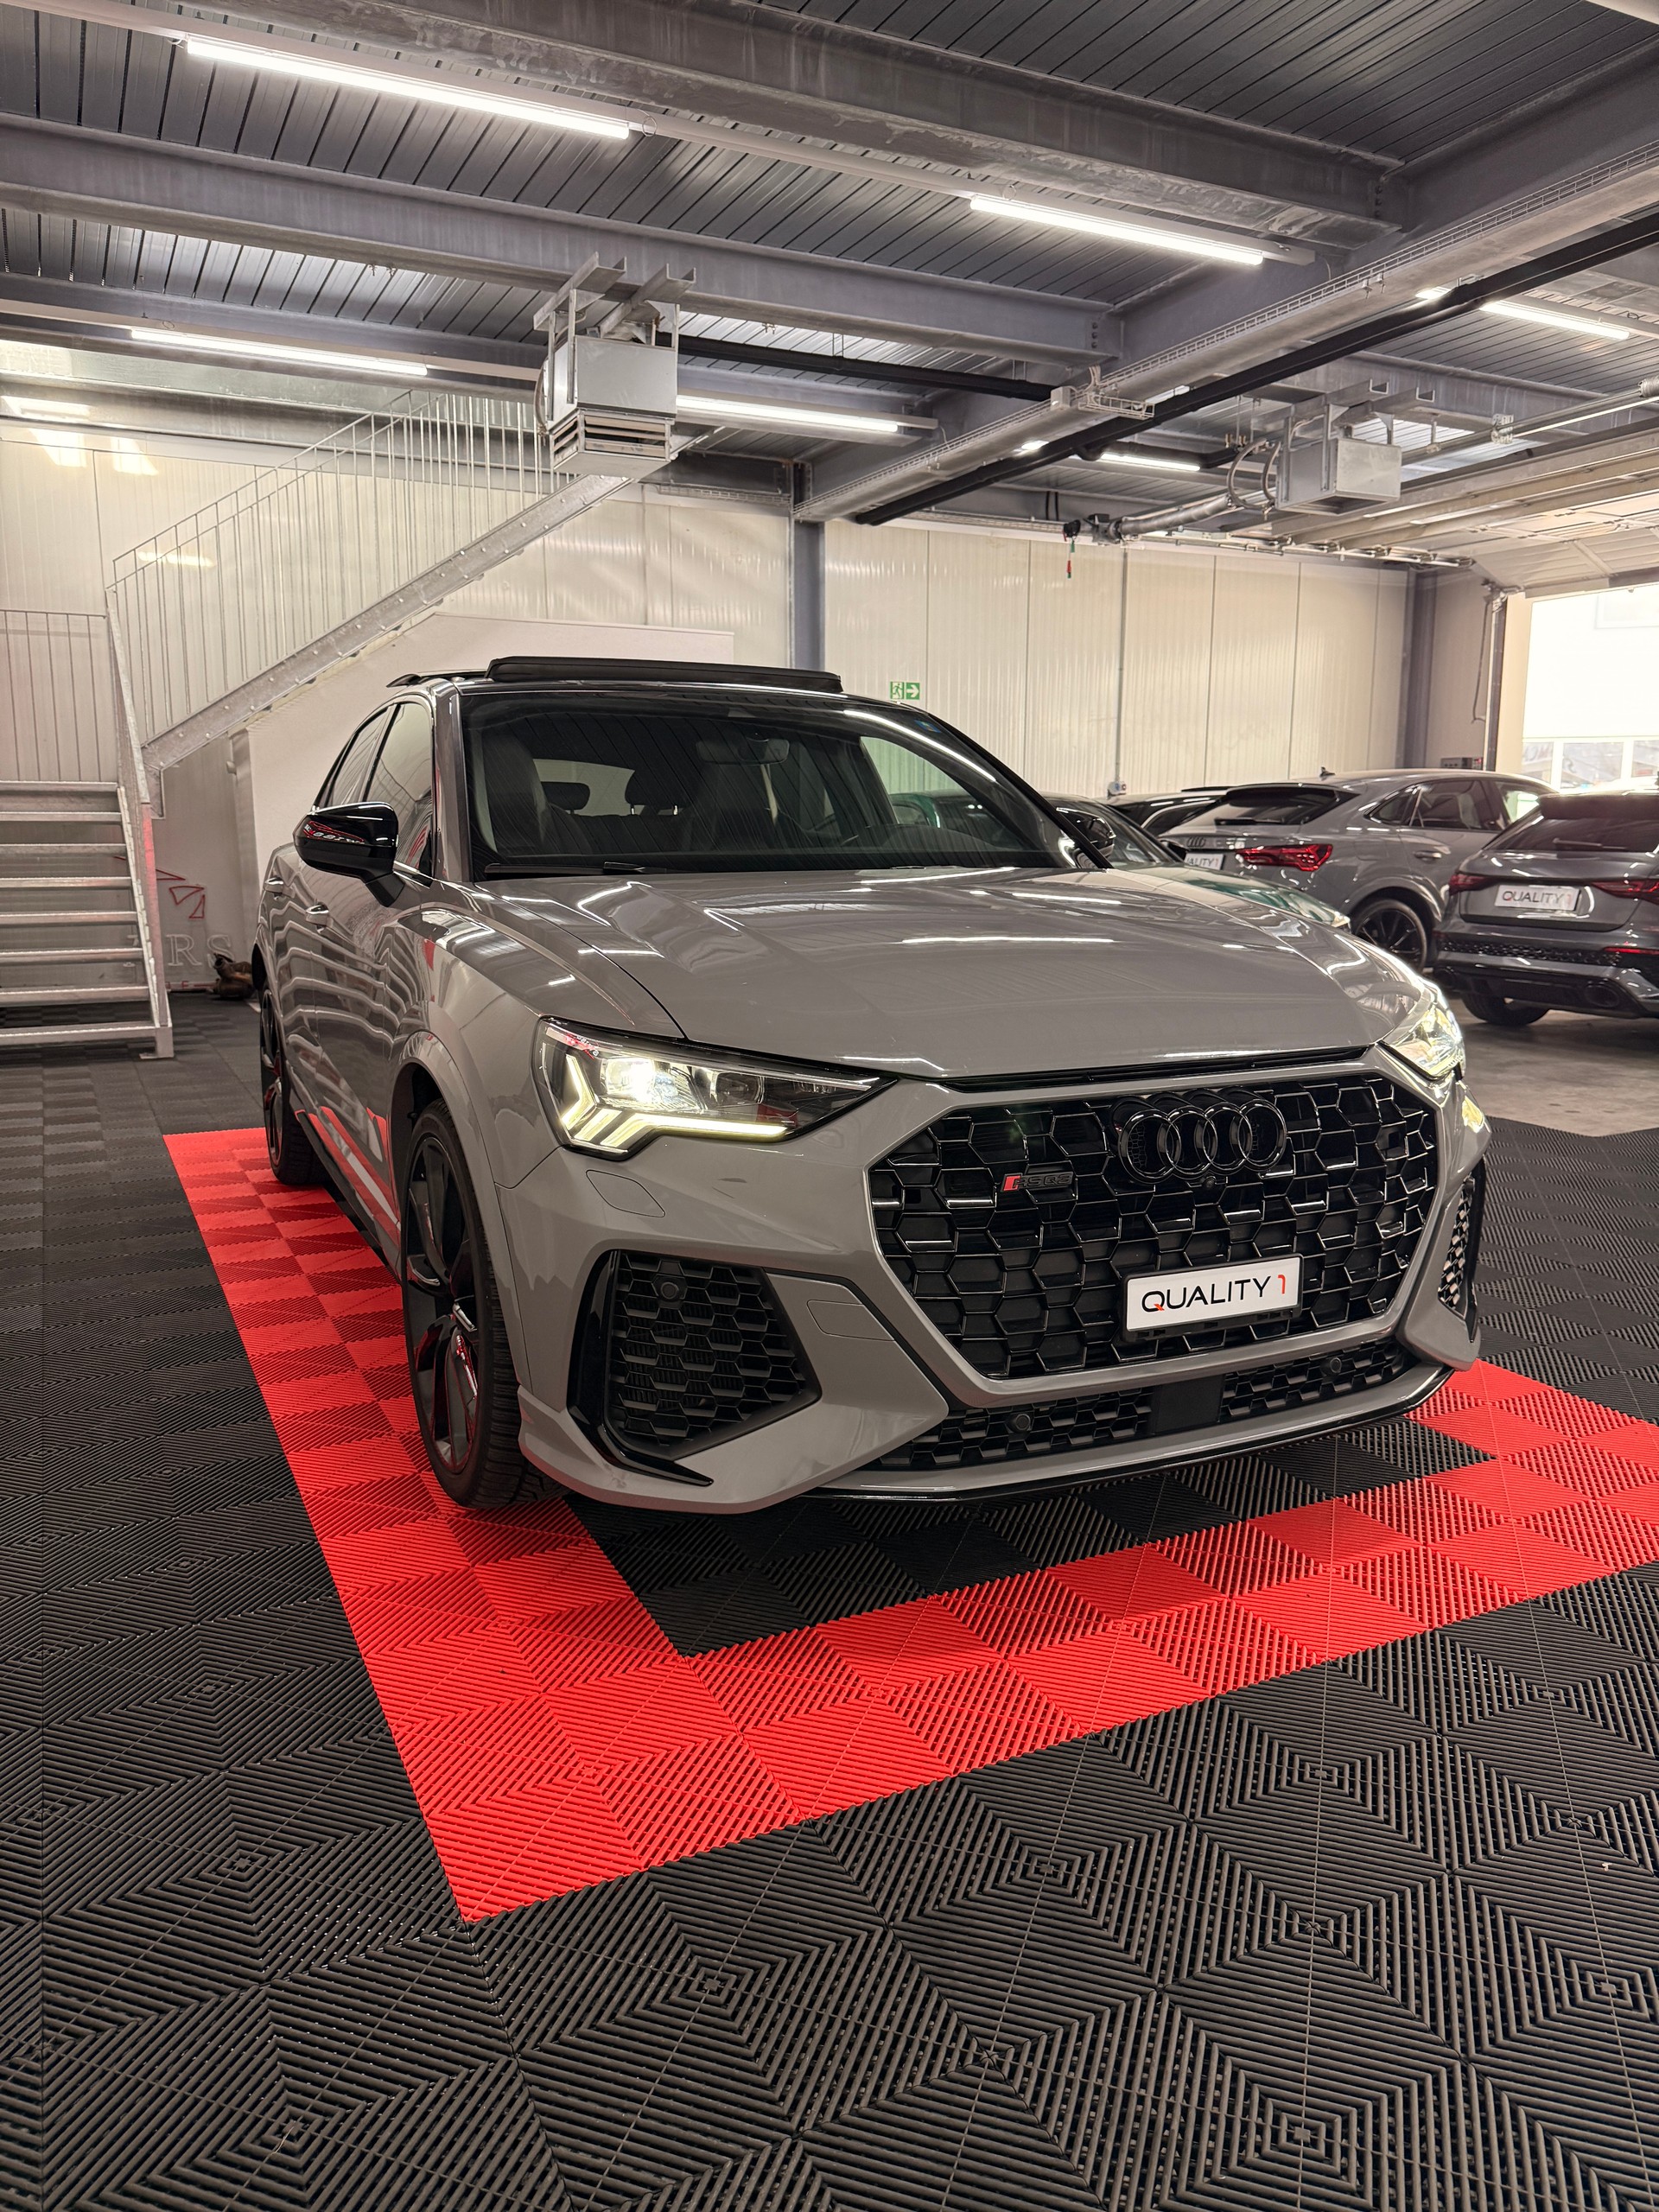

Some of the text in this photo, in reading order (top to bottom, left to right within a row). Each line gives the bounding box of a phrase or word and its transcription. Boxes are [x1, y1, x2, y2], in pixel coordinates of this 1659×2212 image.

[1502, 890, 1573, 905] QUALITY 1
[1141, 1274, 1287, 1313] QUALITY 1
